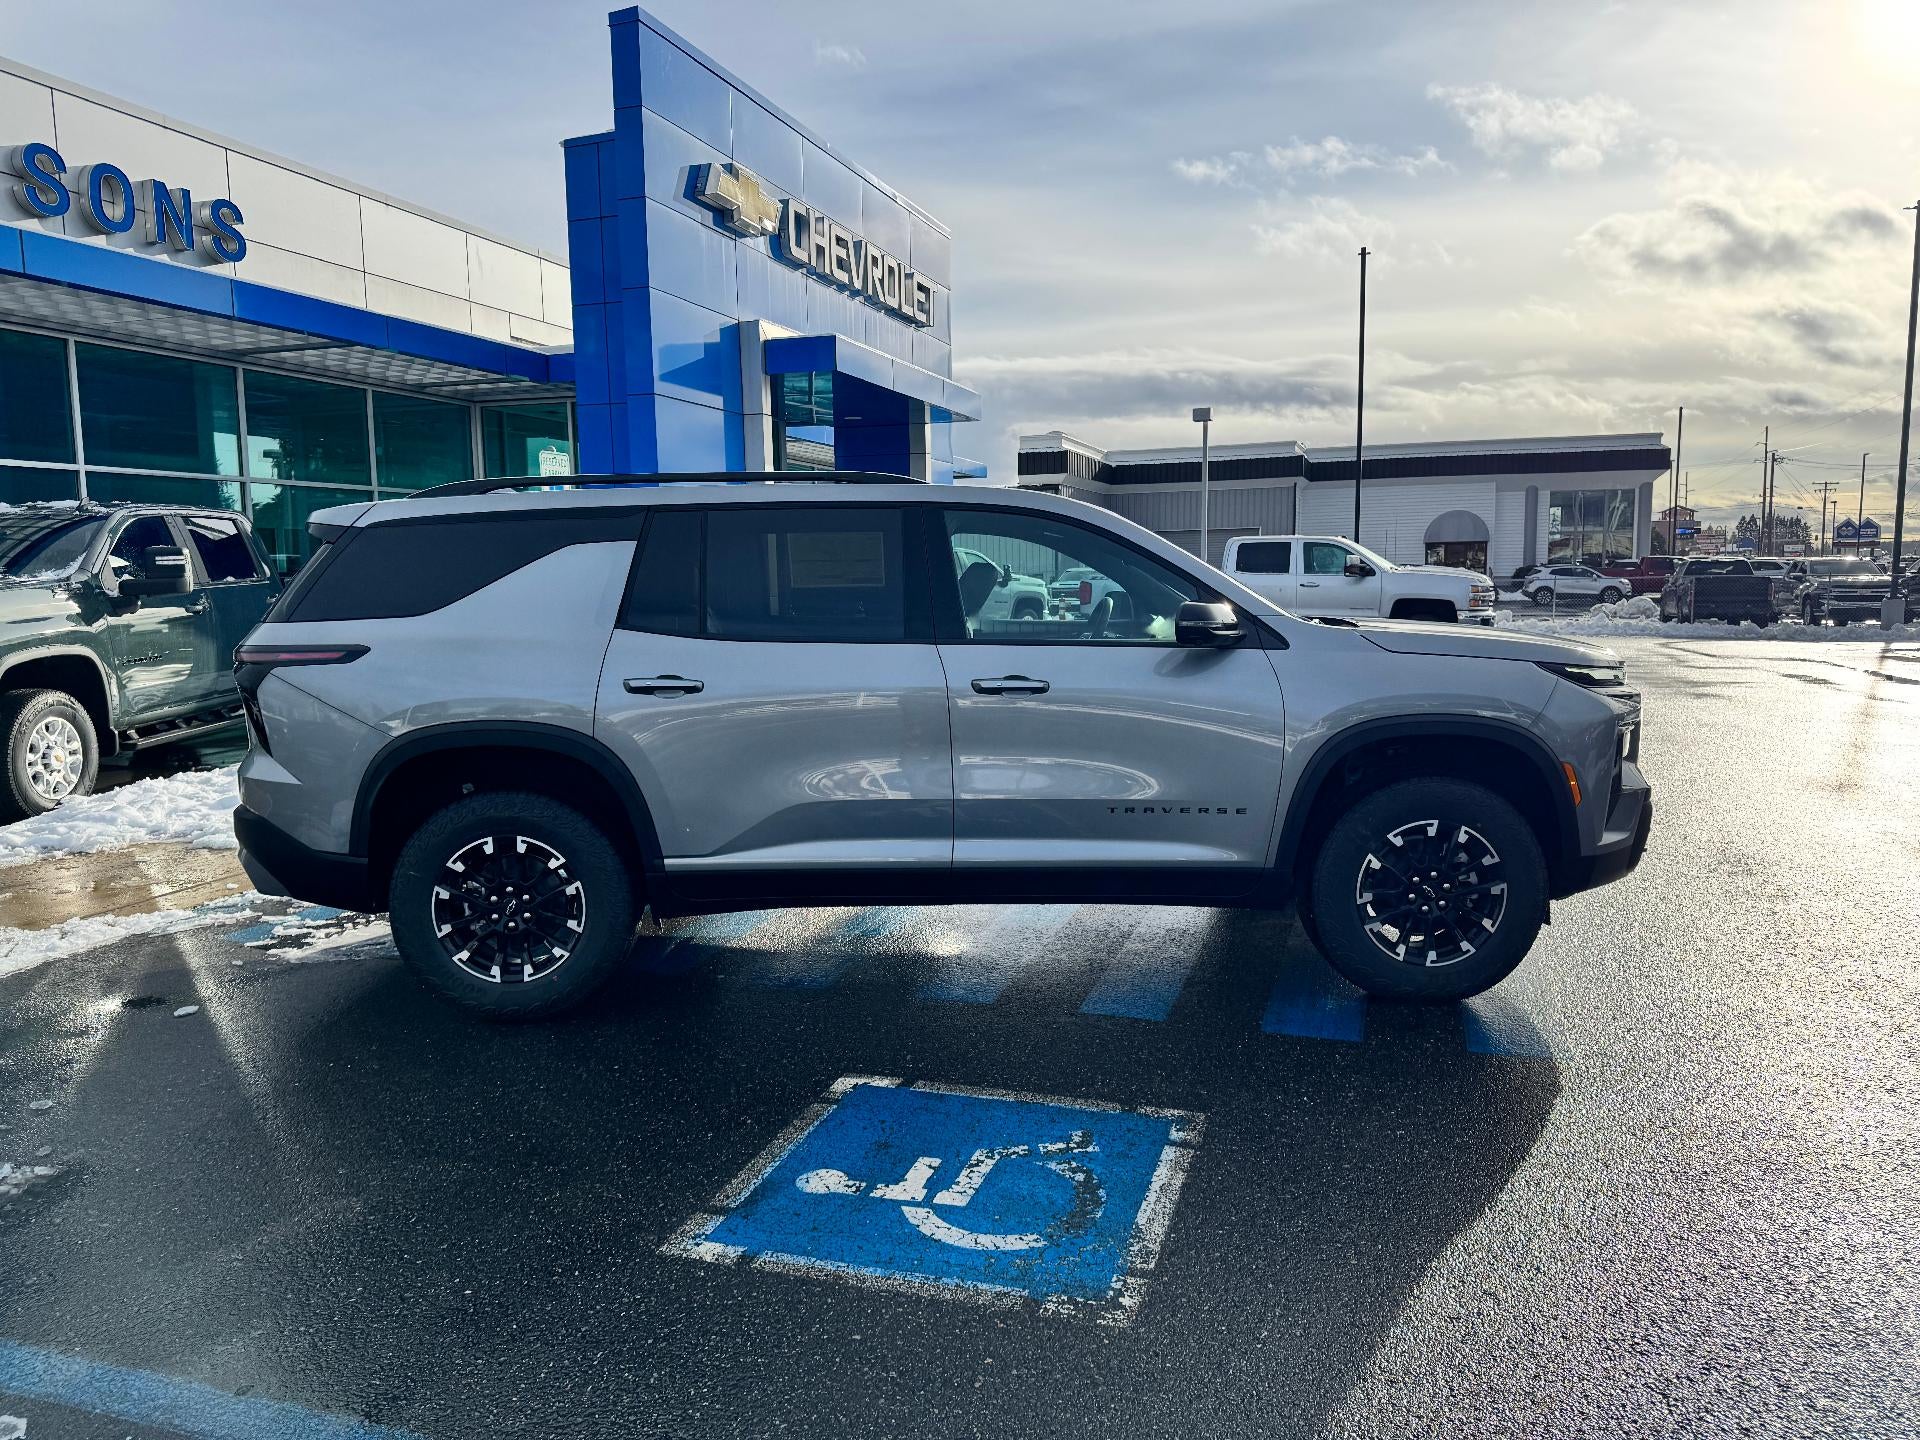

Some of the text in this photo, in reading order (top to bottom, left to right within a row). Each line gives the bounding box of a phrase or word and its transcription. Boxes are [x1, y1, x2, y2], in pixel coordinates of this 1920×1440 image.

[20, 142, 248, 264] SONS
[783, 198, 938, 328] CHEVROLET
[1107, 806, 1248, 815] TRAVERSE
